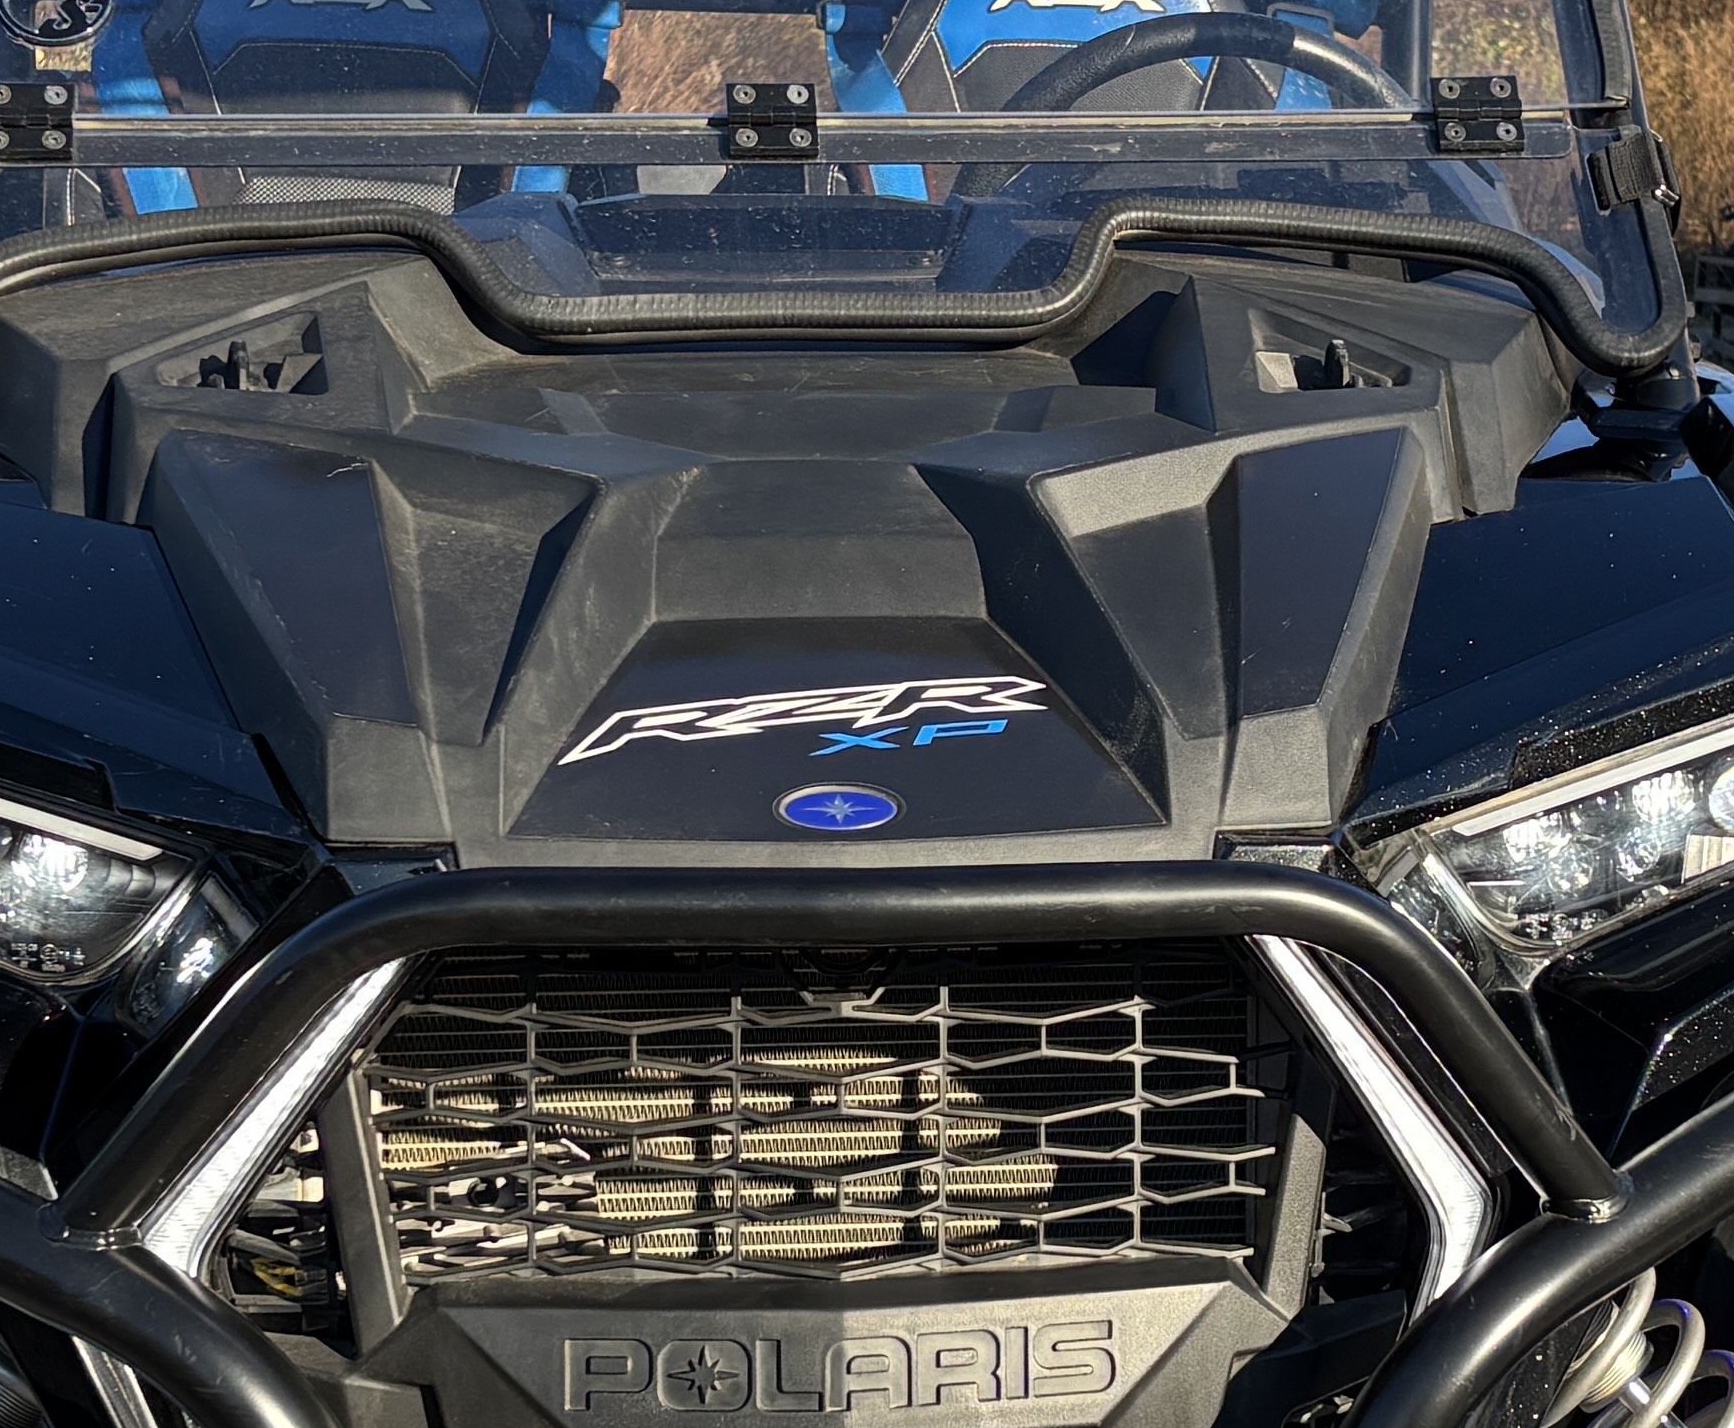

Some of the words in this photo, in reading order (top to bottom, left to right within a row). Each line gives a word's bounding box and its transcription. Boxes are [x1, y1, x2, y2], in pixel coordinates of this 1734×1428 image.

[558, 676, 1048, 766] RZR
[809, 719, 1008, 756] XP
[565, 1320, 1116, 1413] POLARIS
